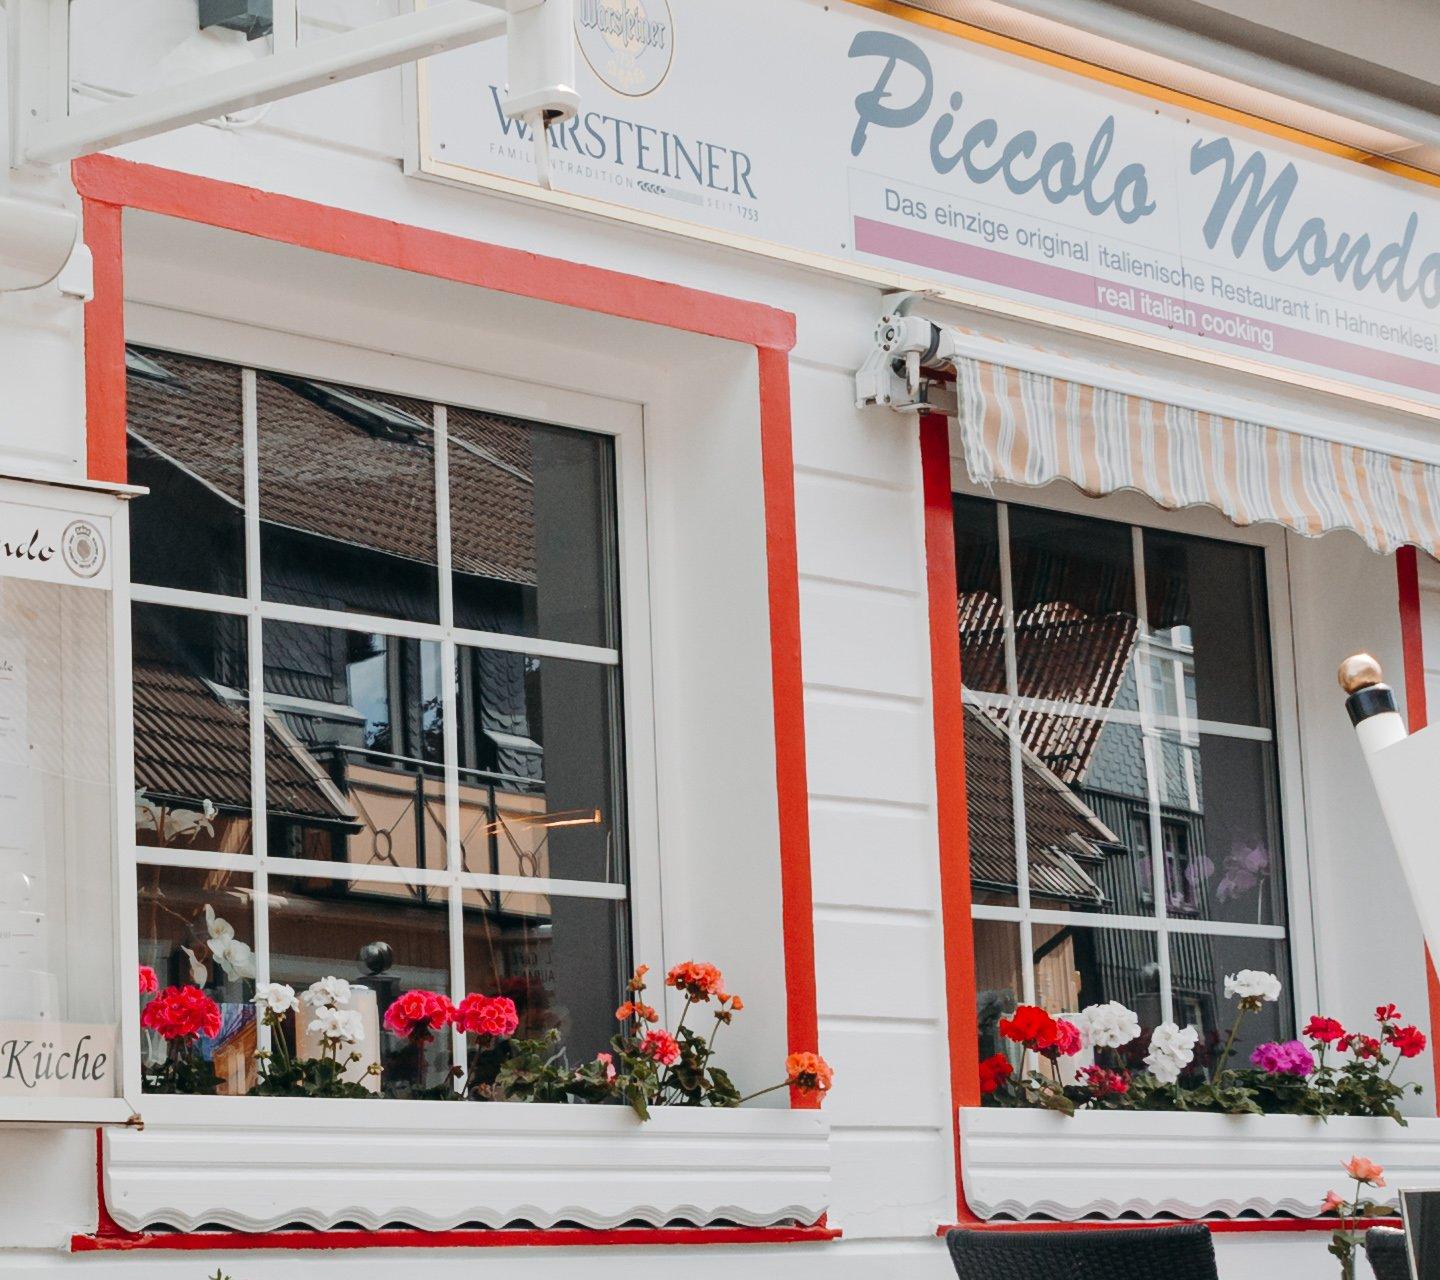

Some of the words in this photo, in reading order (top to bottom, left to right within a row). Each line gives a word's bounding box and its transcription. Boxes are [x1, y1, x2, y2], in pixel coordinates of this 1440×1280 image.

[847, 29, 1157, 224] Piccolo
[736, 205, 760, 223] 1753
[884, 188, 928, 220] Das
[934, 204, 1009, 243] einzige
[1016, 226, 1089, 262] original
[1098, 244, 1205, 293] italienische
[1211, 275, 1310, 321] Restaurant
[1315, 305, 1330, 326] in
[1334, 307, 1440, 354] Hahnenklee!
[1096, 283, 1136, 311] real
[1140, 291, 1197, 329] italian
[1201, 313, 1275, 352] cooking
[0, 1034, 108, 1089] Küche
